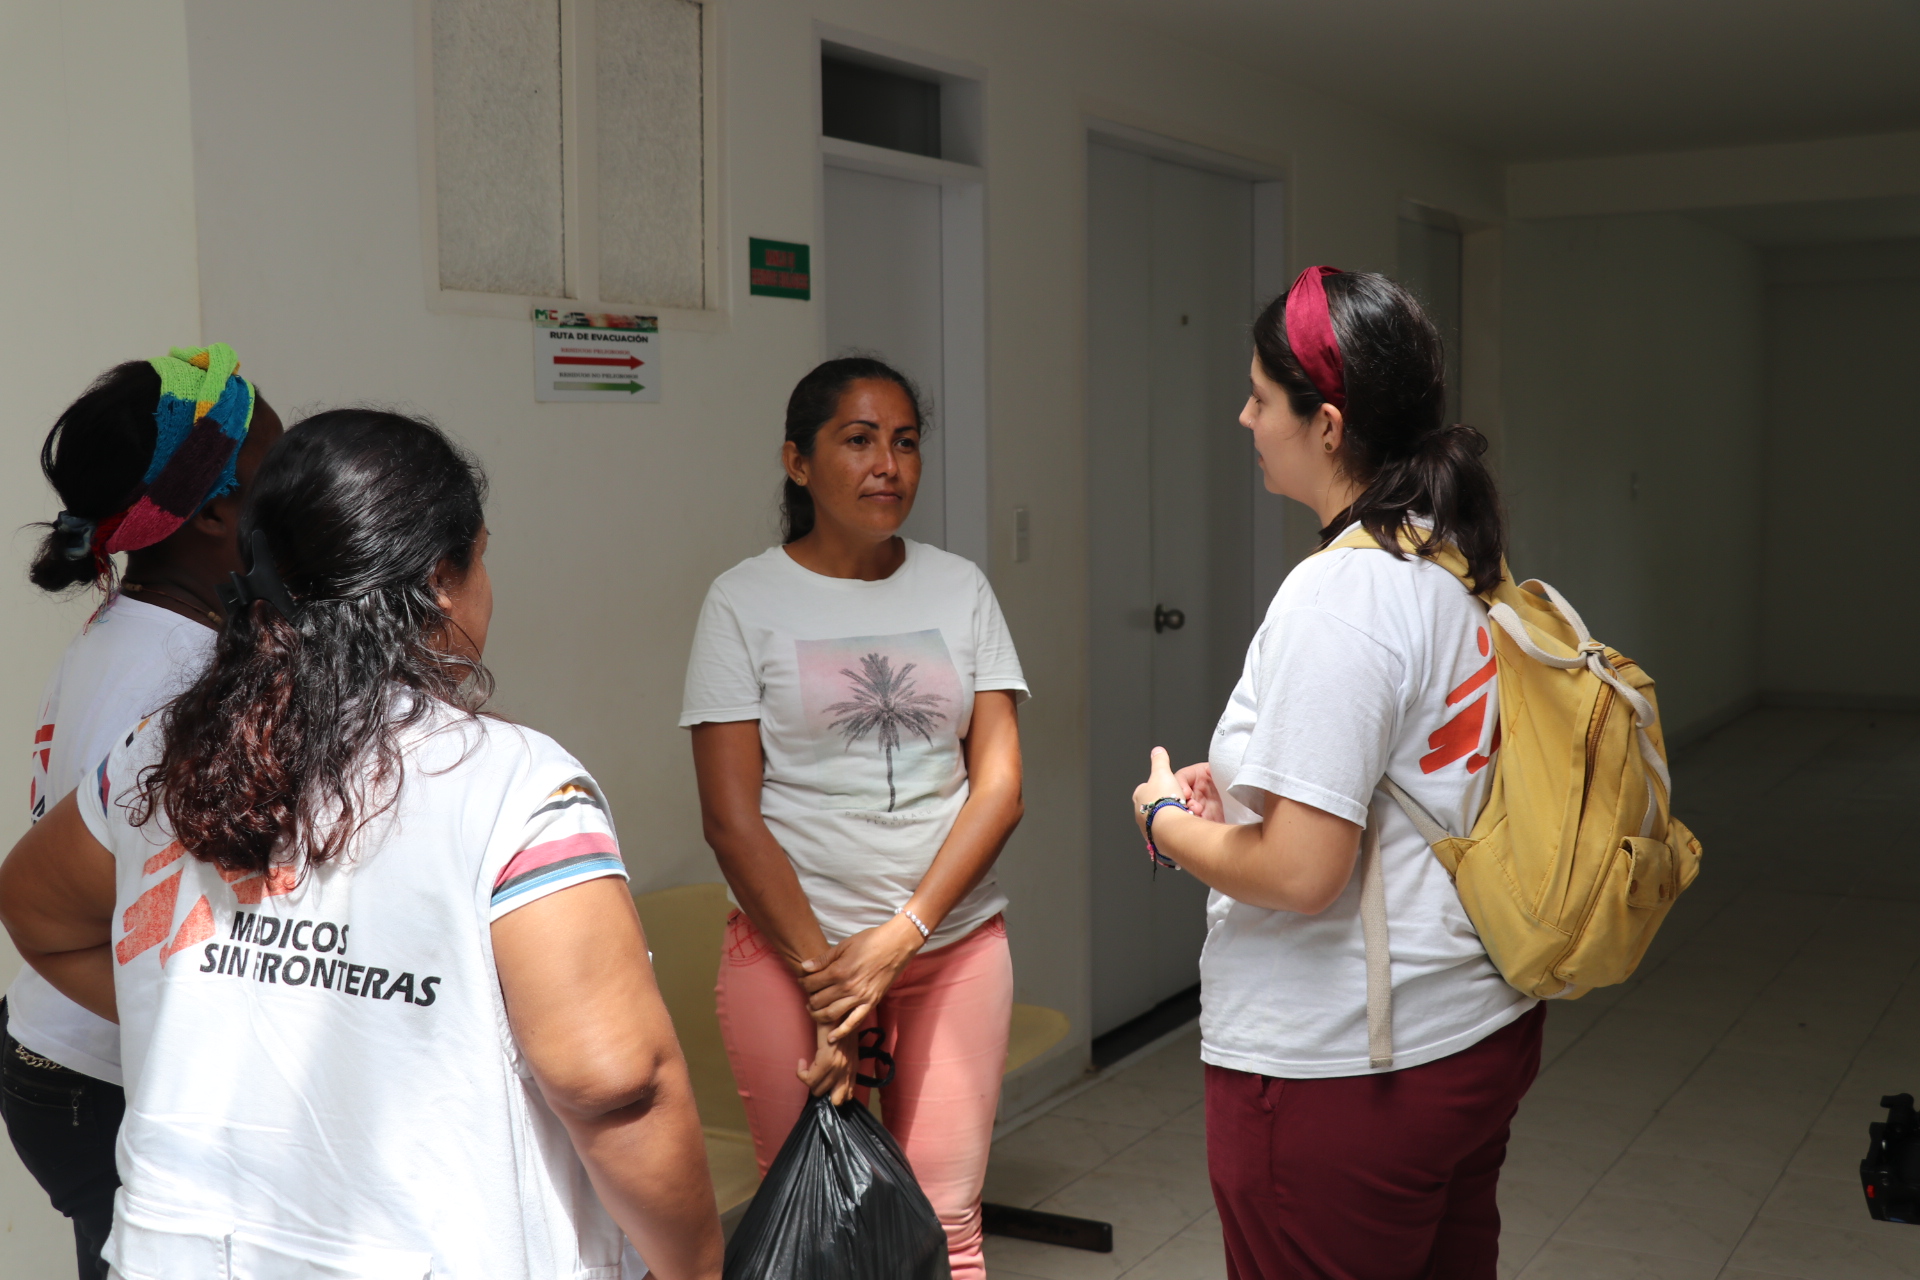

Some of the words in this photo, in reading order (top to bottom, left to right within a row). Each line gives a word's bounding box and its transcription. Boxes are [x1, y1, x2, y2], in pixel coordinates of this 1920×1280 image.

[549, 331, 575, 340] RUTA
[576, 333, 589, 341] DE
[591, 333, 649, 344] EVACUACIÓN
[559, 371, 591, 379] RESIDUOS
[199, 943, 250, 978] SIN
